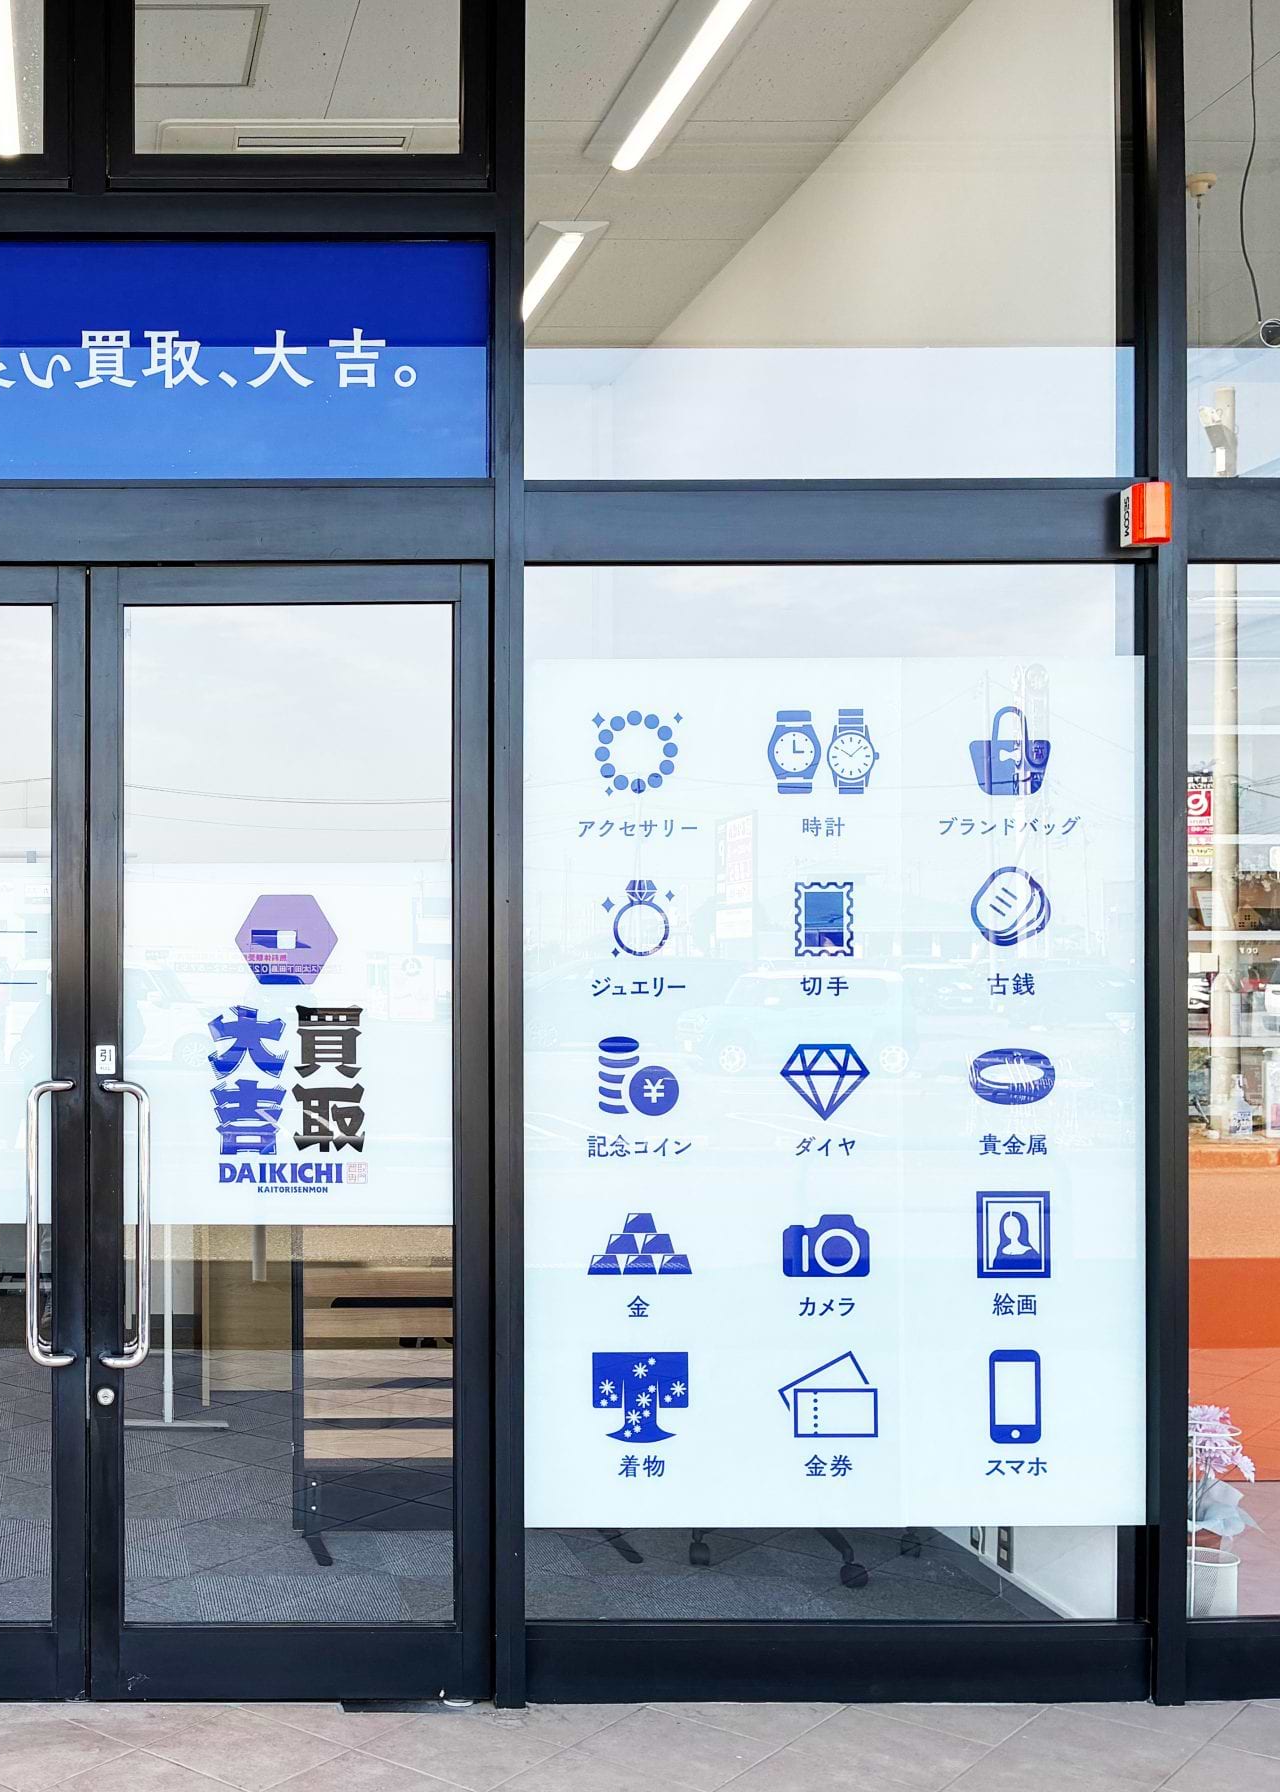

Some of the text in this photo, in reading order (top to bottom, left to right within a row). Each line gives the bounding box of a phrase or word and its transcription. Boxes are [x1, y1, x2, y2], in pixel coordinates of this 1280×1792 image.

[578, 819, 698, 838] アクセサリー
[802, 816, 845, 838] 時計
[939, 815, 1081, 836] ブランドバッグ
[591, 976, 687, 998] ジュエリー
[799, 976, 850, 997] 切手
[986, 972, 1036, 996] 古銭
[208, 1005, 288, 1155] 大吉
[292, 1005, 365, 1152] 買取
[586, 1134, 692, 1158] 記念コイン
[795, 1136, 856, 1157] ダイヤ
[978, 1133, 1048, 1156] 貴金属
[218, 1162, 344, 1184] DAIKICHI
[257, 1186, 328, 1194] KAITORISENMON
[626, 1295, 651, 1318] 金
[798, 1296, 856, 1317] カメラ
[991, 1292, 1037, 1317] 絵画
[617, 1454, 666, 1478] 着物
[803, 1453, 853, 1478] 金券
[985, 1456, 1048, 1477] スマホ
